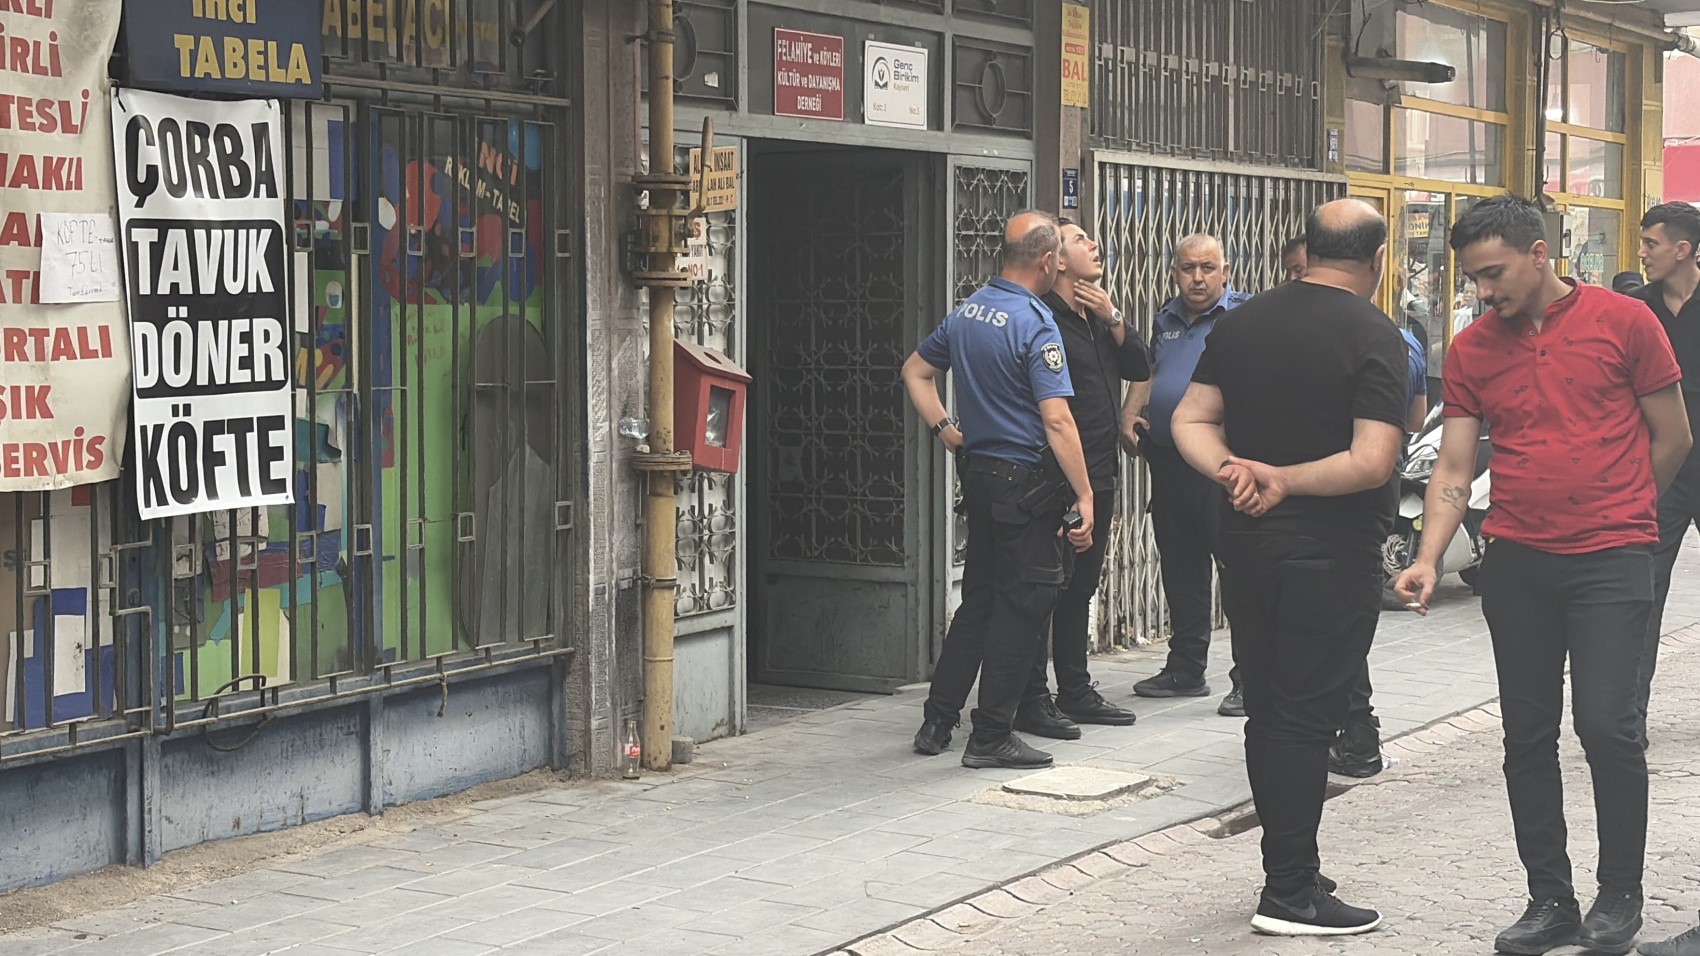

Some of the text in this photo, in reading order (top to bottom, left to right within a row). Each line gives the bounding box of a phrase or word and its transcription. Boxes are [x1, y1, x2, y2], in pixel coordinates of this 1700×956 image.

[173, 33, 312, 85] TABELA
[777, 36, 813, 64] FELAHİYE
[820, 47, 842, 67] KÖYLERİ
[893, 59, 914, 73] Genç
[777, 67, 801, 87] KÜLTÜR
[808, 74, 841, 93] DAYANIŞMA
[893, 70, 920, 84] Birikim
[1062, 58, 1088, 82] BAL
[797, 94, 822, 112] DERNEĞİ
[125, 114, 278, 208] ÇORBA
[1068, 180, 1075, 194] 5
[131, 228, 275, 295] TAVUK
[3, 325, 113, 362] RTALI
[133, 306, 286, 389] DÖNER
[0, 426, 106, 478] ERVİS
[139, 403, 287, 509] KÖFTE
